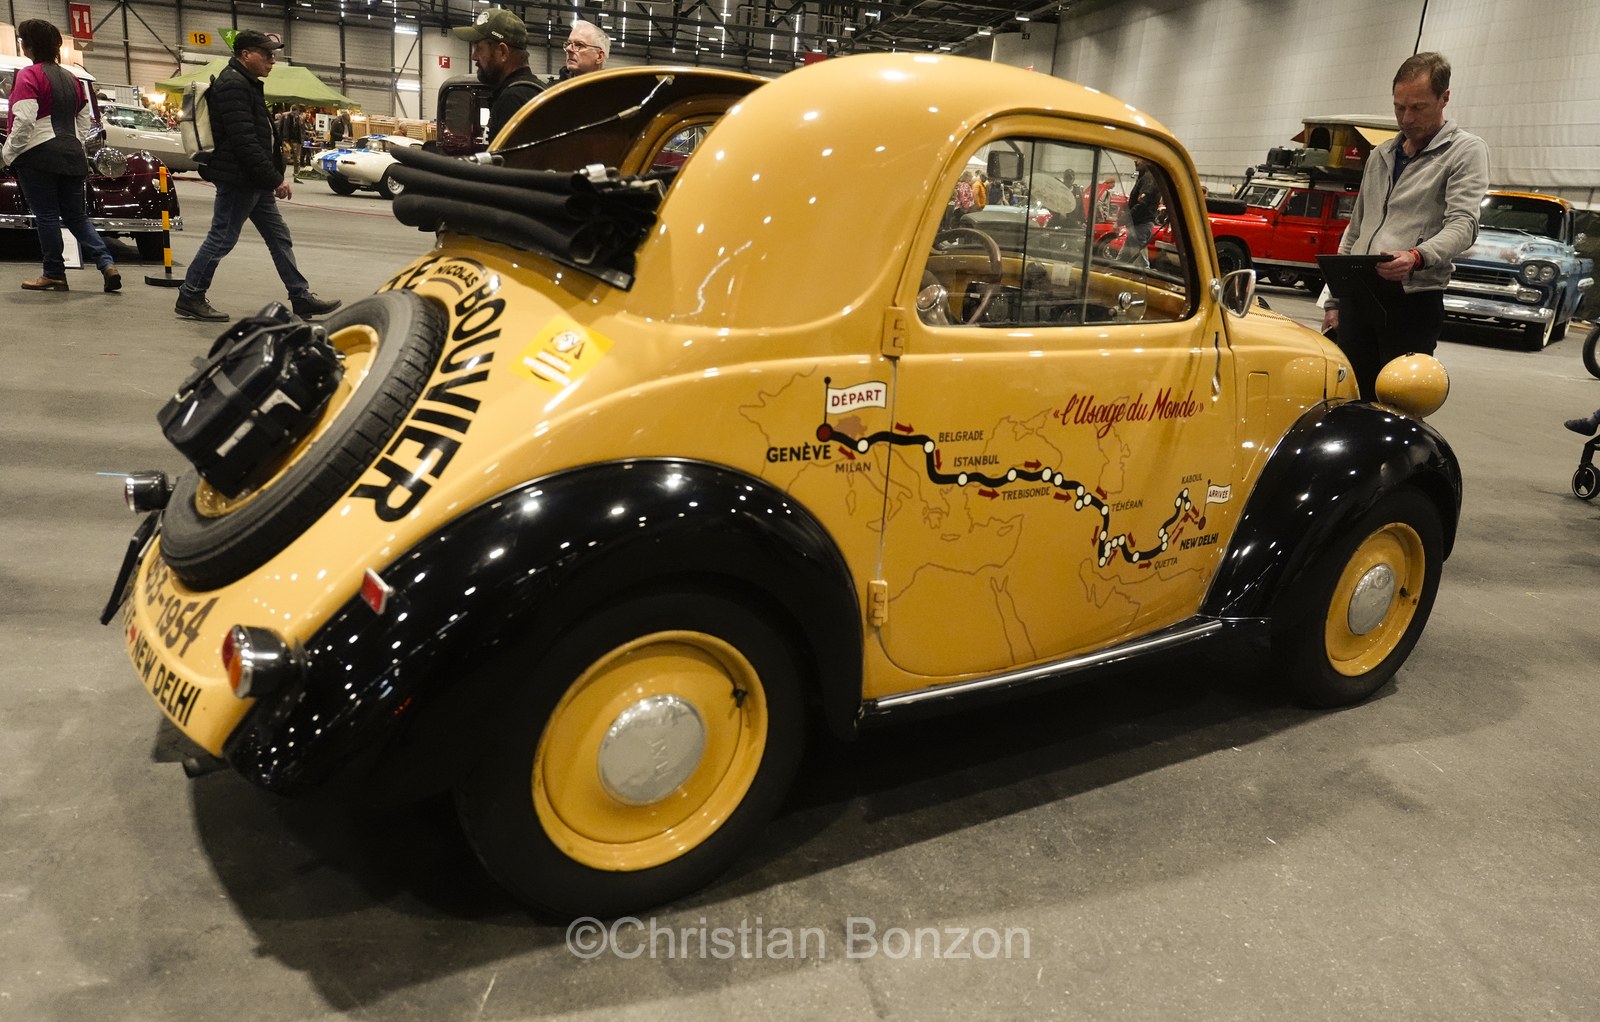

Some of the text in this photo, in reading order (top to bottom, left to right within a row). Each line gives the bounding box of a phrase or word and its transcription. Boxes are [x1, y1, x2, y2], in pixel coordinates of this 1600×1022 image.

[193, 33, 207, 44] 18
[441, 57, 448, 66] F
[433, 264, 480, 289] NICOLAS
[348, 275, 506, 522] BOUVIER
[831, 389, 882, 407] DÉPART
[1126, 393, 1147, 421] du
[938, 430, 984, 442] BELGRADE
[766, 441, 832, 463] GENÈVE
[835, 461, 872, 474] MILAN
[953, 454, 1000, 468] ISTANBUL
[1181, 473, 1203, 484] KABOUL
[1001, 486, 1050, 501] TREBISONDE
[1208, 487, 1229, 499] ARRIVÉE
[1111, 499, 1144, 513] TÉHÉRAN
[1179, 532, 1219, 551] NEW DELHI
[1153, 556, 1178, 571] QUETTA
[131, 630, 202, 727] NEW DELHI
